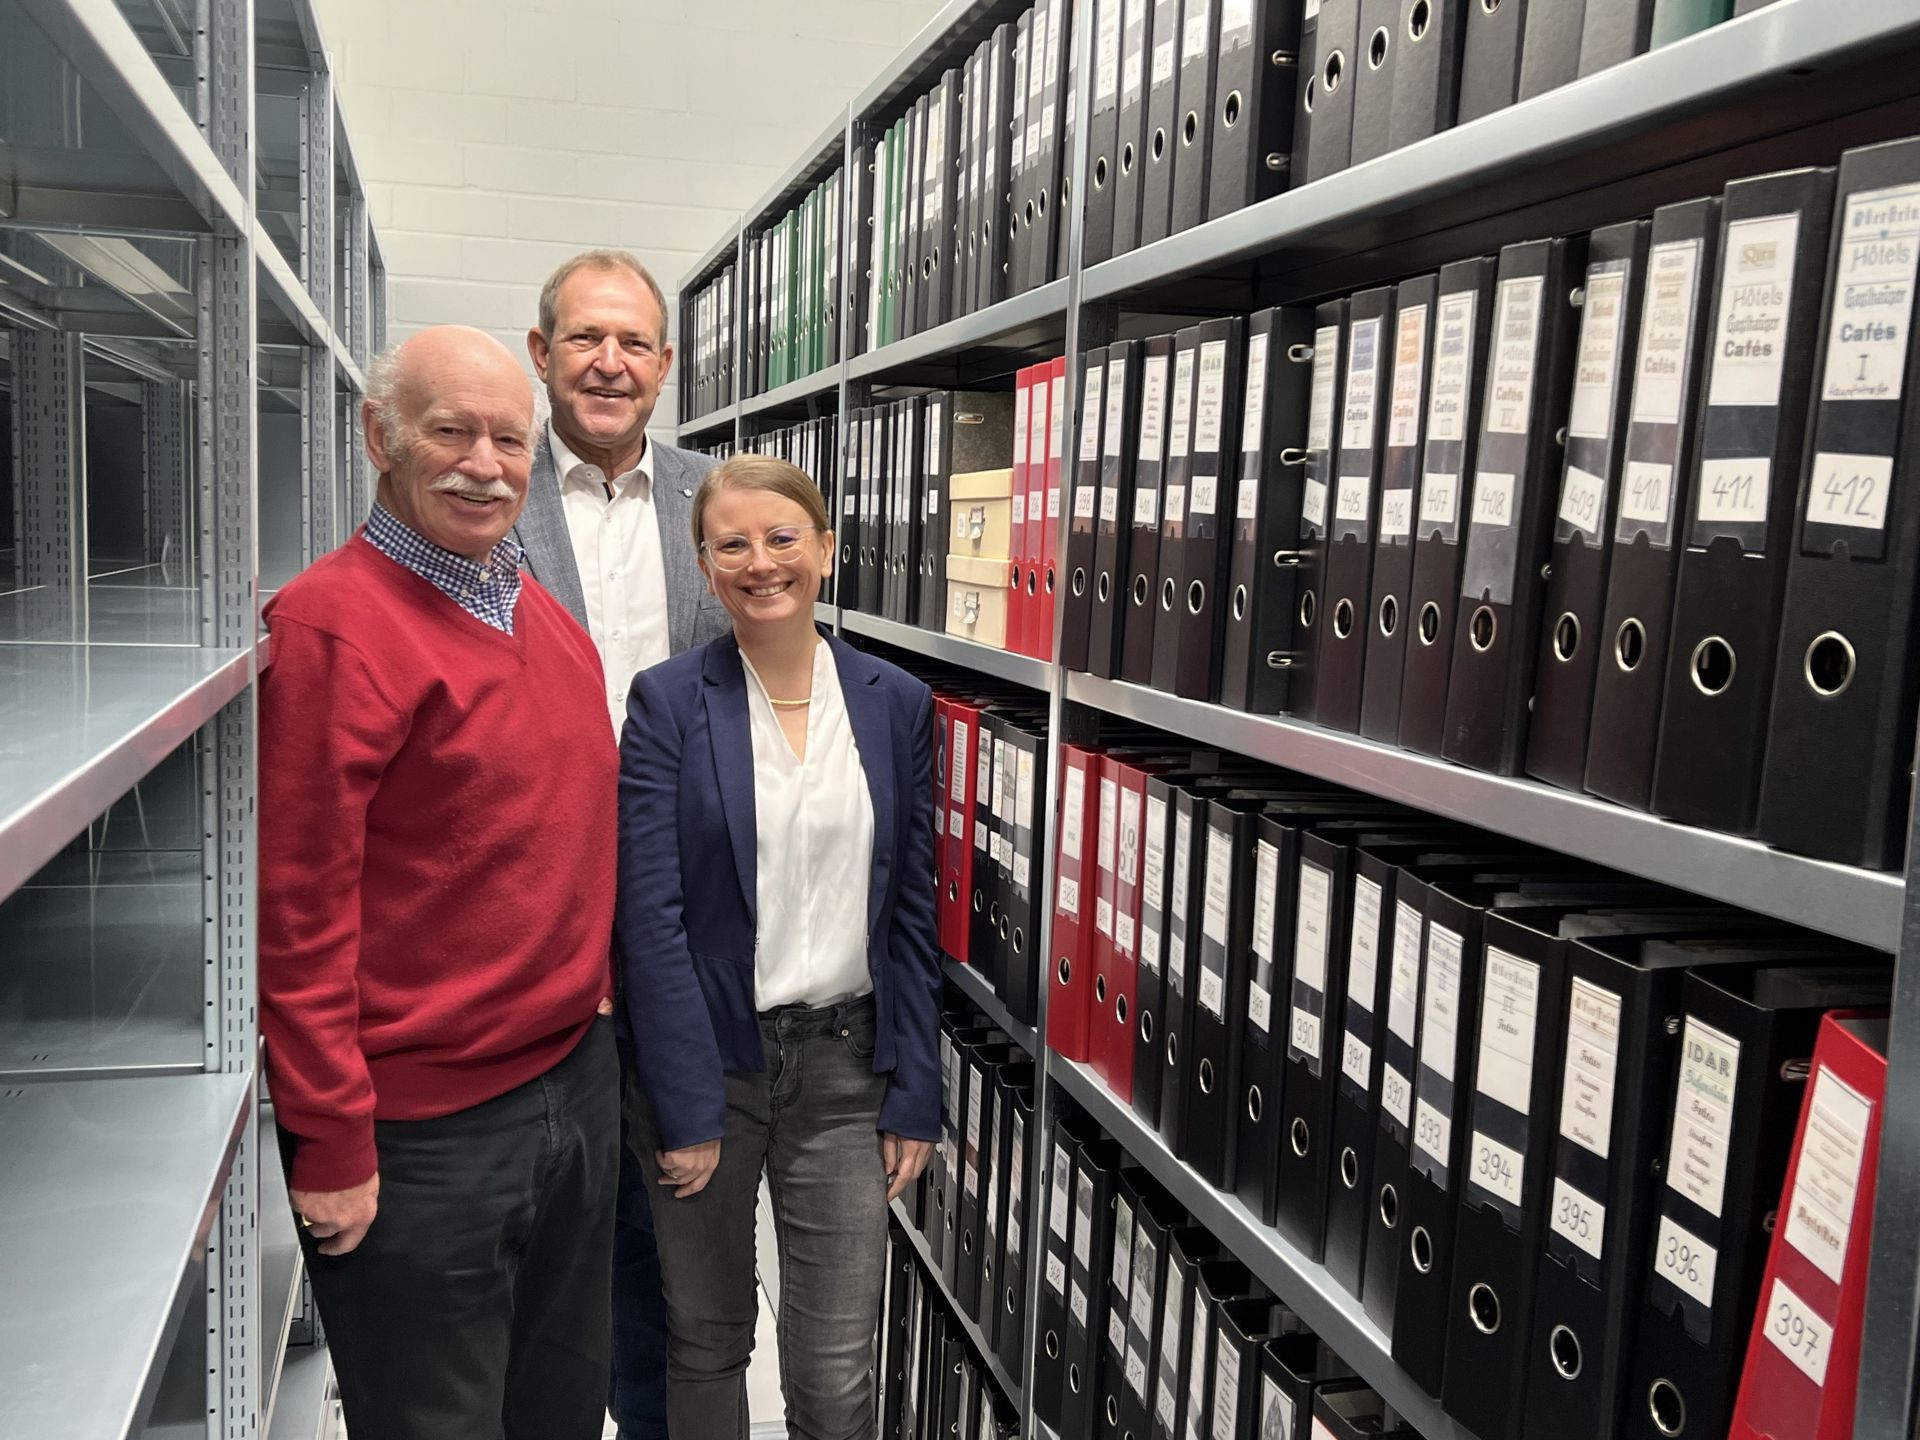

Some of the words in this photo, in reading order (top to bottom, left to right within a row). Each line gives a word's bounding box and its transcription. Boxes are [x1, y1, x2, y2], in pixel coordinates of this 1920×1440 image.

[1851, 240, 1911, 273] Hôtels
[1732, 287, 1783, 311] Hôtels
[1840, 323, 1897, 345] Cafés
[1723, 340, 1773, 359] Cafés
[1643, 357, 1678, 374] Cafés
[1578, 367, 1607, 385] Cafés
[1495, 387, 1525, 403] Cafés
[1345, 408, 1369, 421] Cafés
[1434, 400, 1458, 414] Cafés
[1686, 1040, 1731, 1078] IDAR
